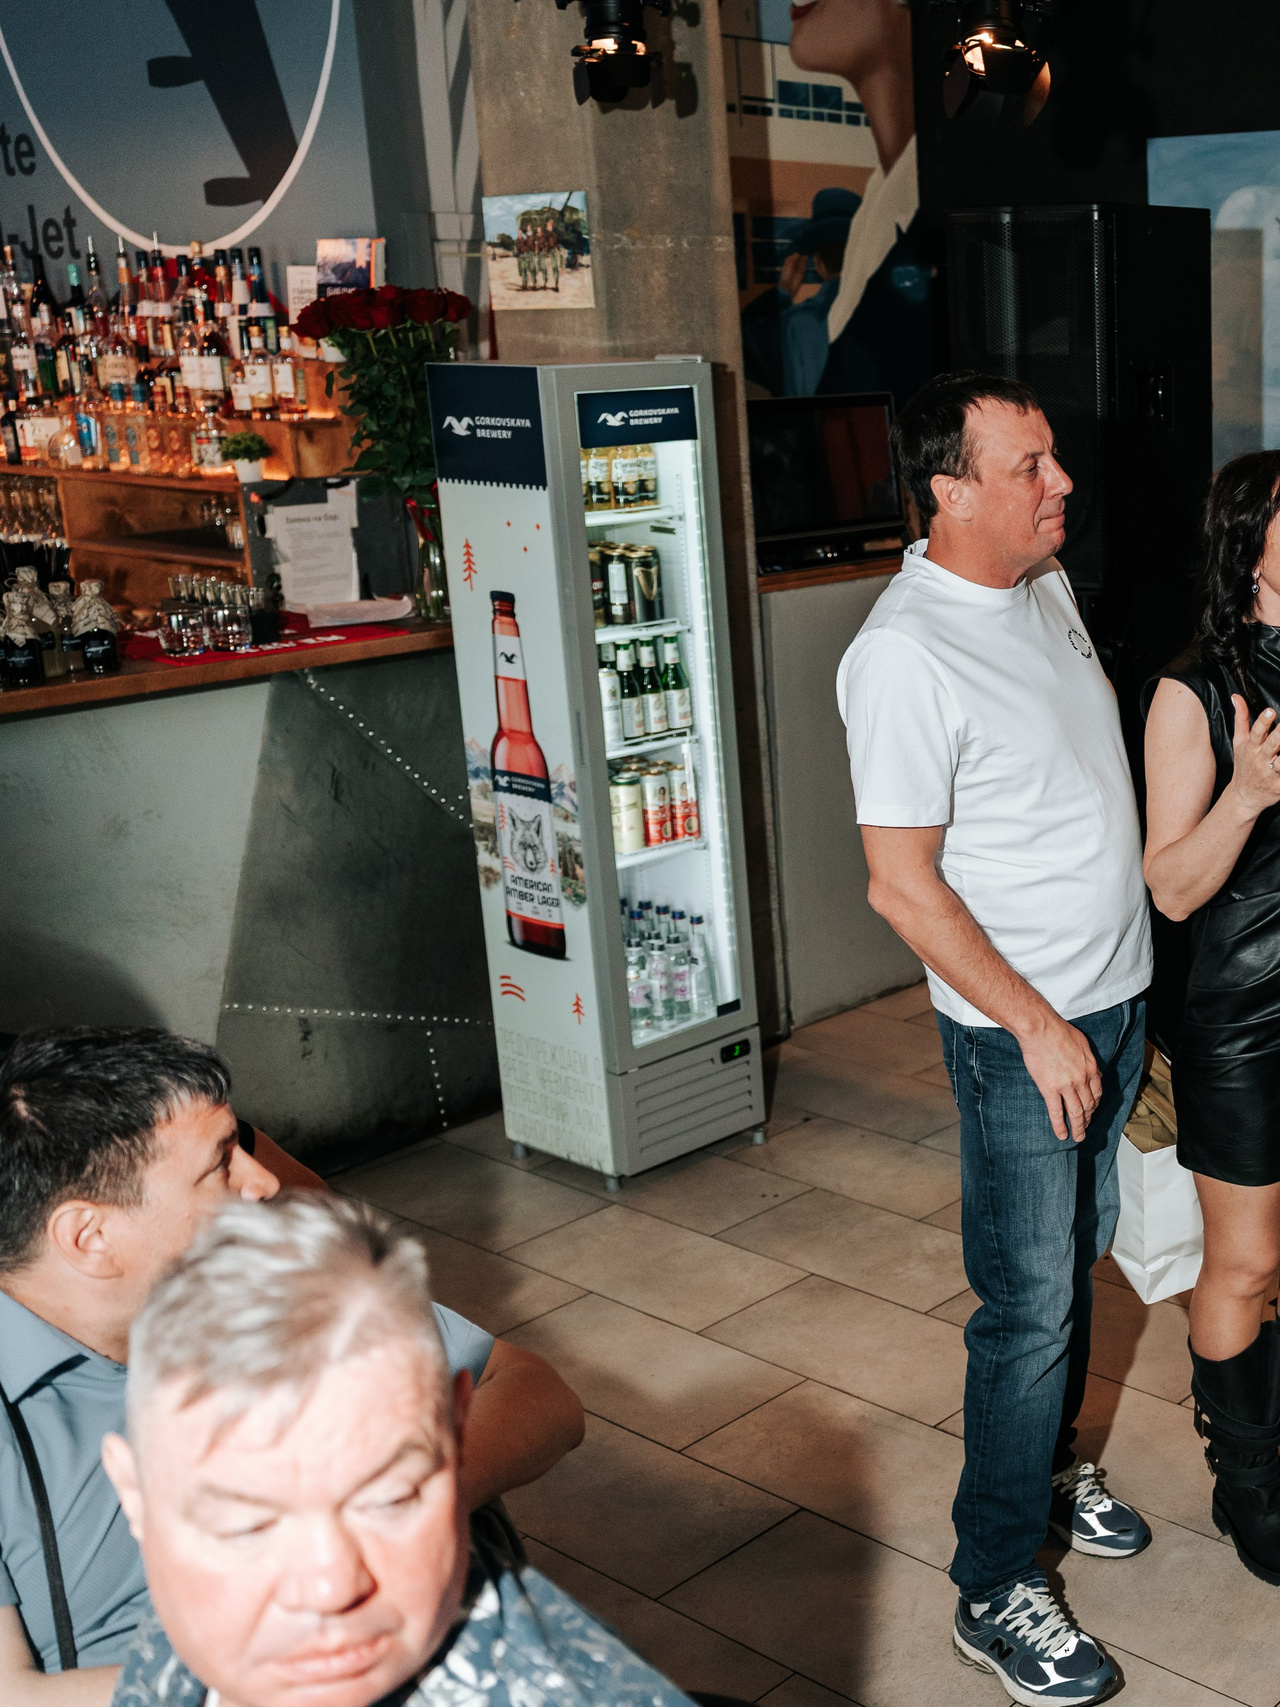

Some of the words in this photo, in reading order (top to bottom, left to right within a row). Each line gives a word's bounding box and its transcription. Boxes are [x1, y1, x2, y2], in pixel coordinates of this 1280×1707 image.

[628, 407, 680, 417] GORKOVSKAYA
[474, 416, 532, 428] GORKOVSKAYA
[629, 416, 663, 426] BREWERY
[475, 428, 512, 439] BREWERY
[510, 874, 553, 893] AMERICAN
[506, 886, 536, 904] AMBER
[537, 894, 561, 909] LAGER
